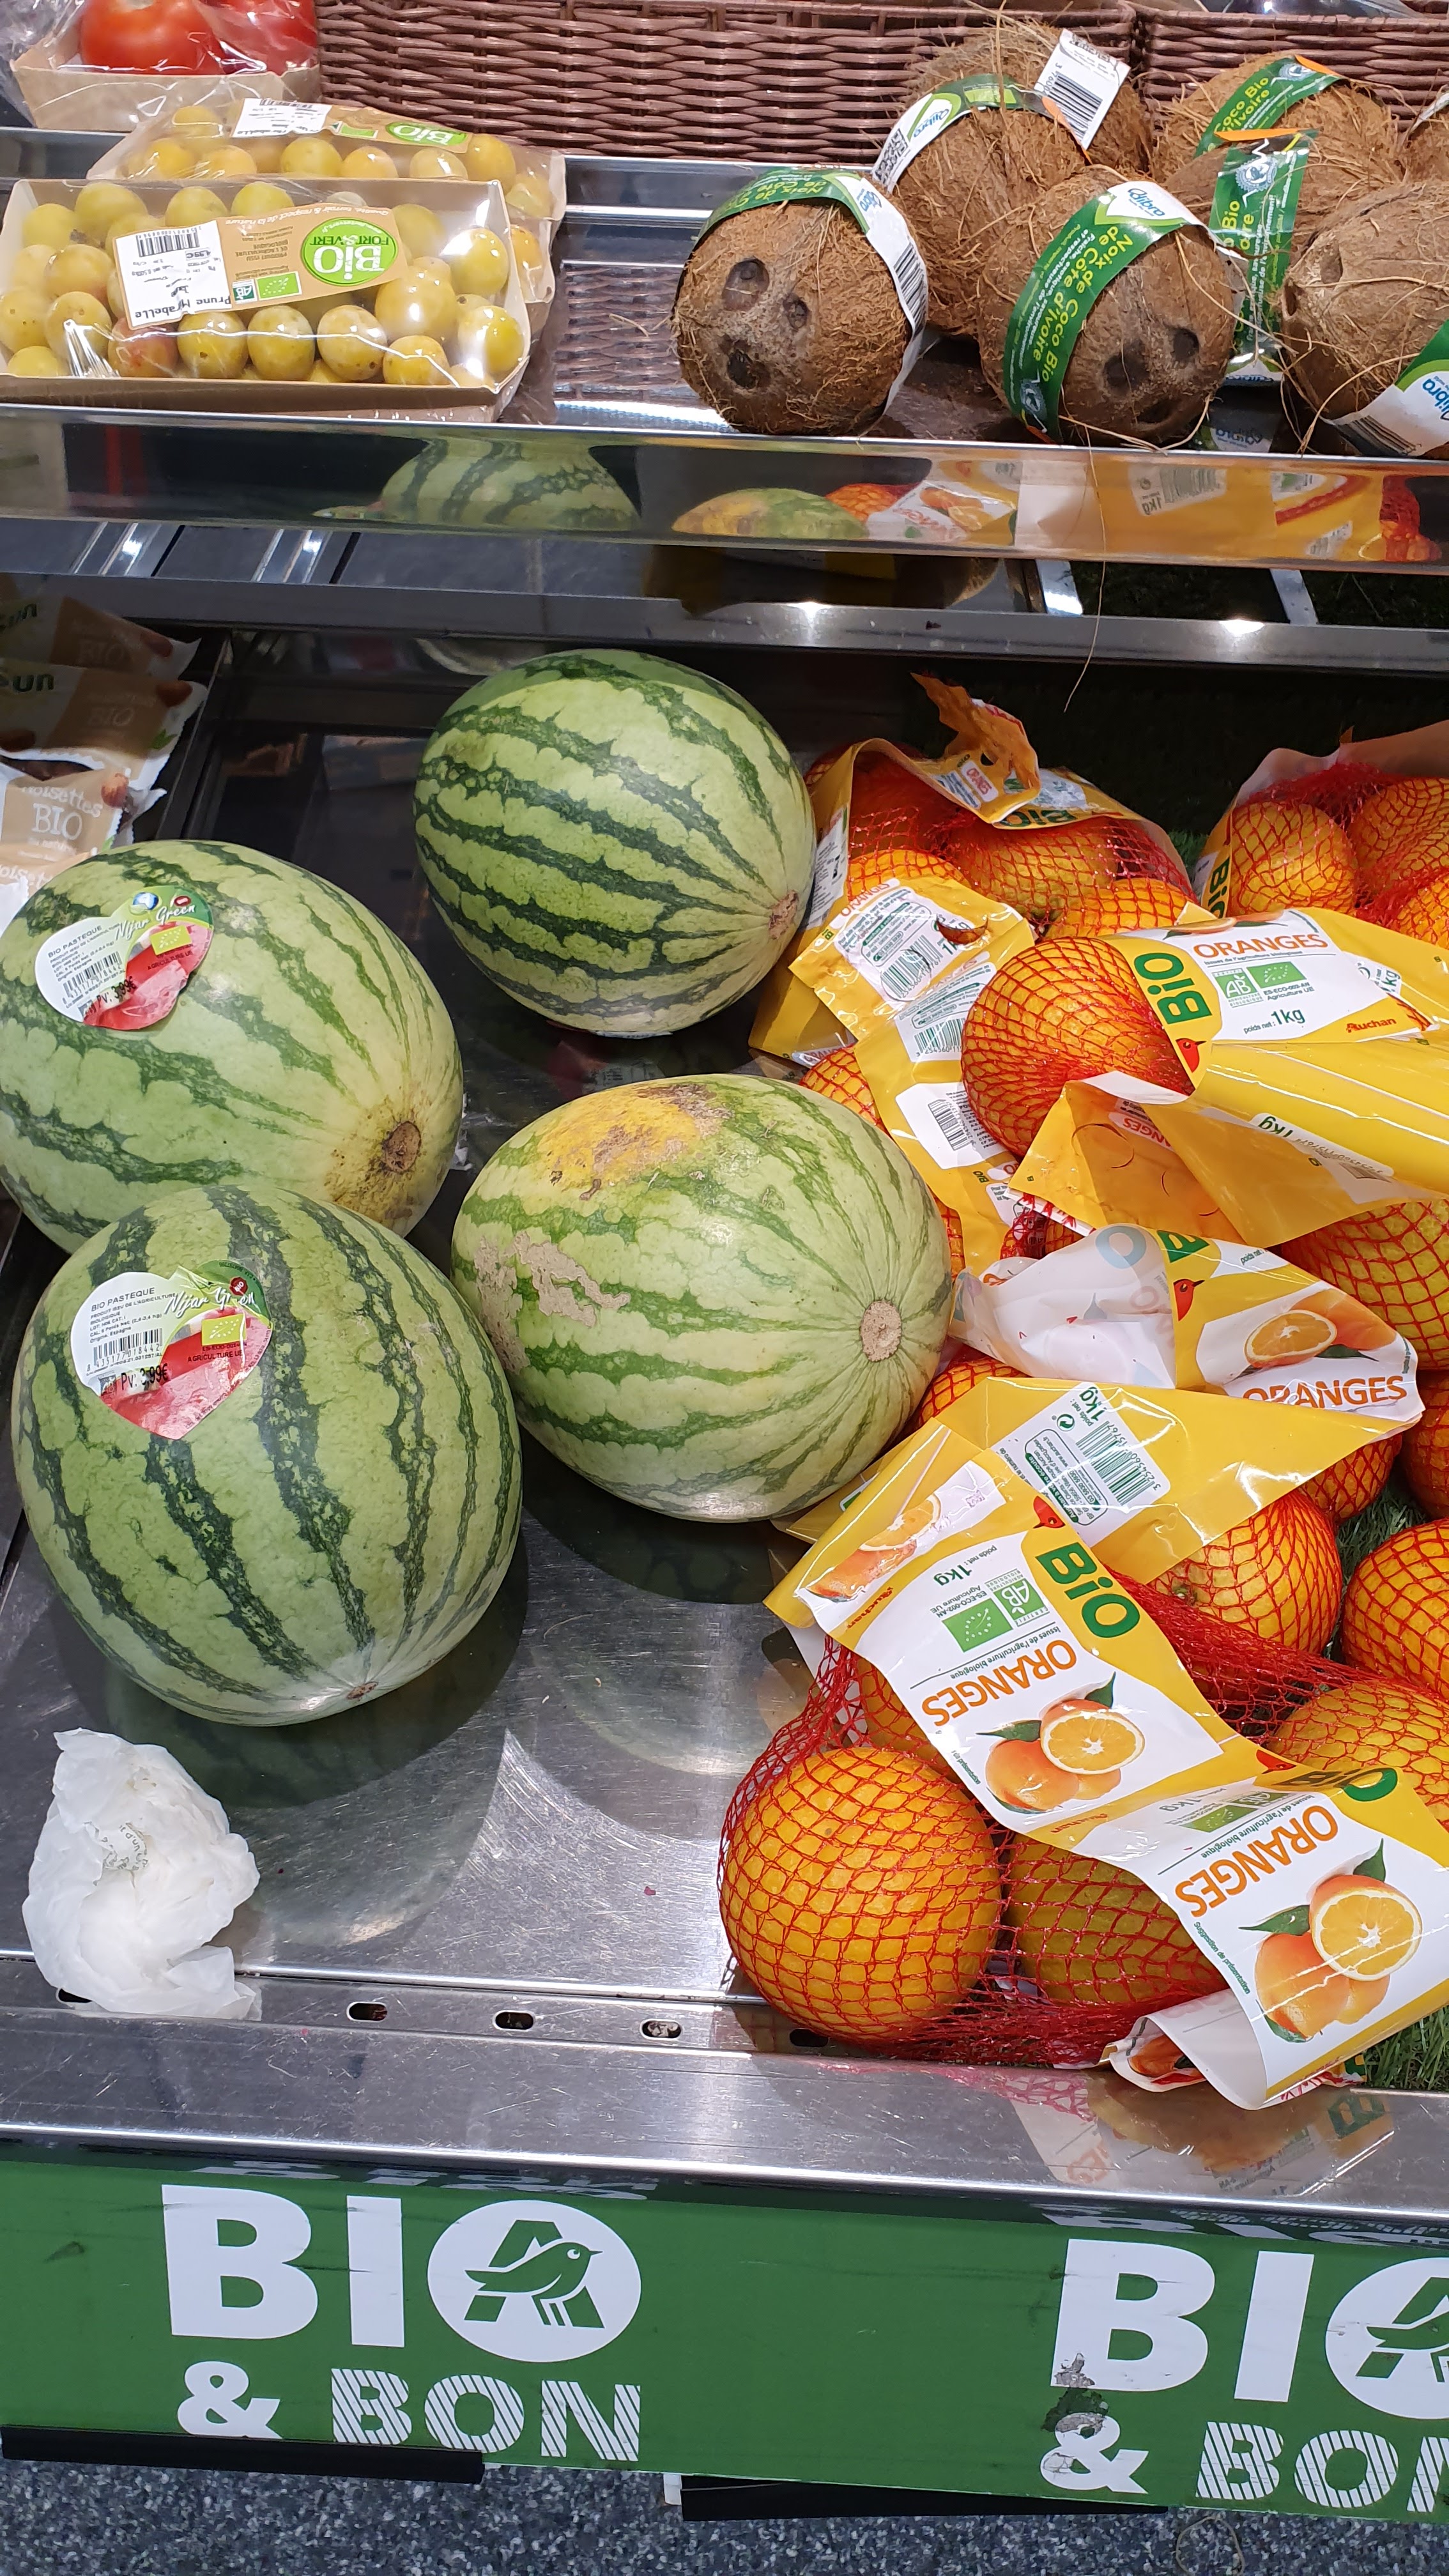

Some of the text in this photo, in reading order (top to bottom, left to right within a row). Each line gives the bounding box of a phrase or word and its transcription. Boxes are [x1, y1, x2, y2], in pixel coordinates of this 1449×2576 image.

[1245, 75, 1269, 99] Bio
[1222, 199, 1241, 229] Bio
[1098, 226, 1119, 246] de
[1062, 247, 1099, 288] Côte
[195, 296, 231, 305] Prune
[1041, 234, 1133, 382] Noix de Coco Bio
[32, 802, 83, 841] BIO
[155, 905, 196, 926] Green
[48, 924, 103, 958] BIO PASTEQUE
[1193, 933, 1328, 962] ORANGES
[1134, 950, 1212, 1025] BiO
[1266, 988, 1303, 1002] Agriculture
[1243, 1023, 1261, 1034] poids
[1271, 1006, 1306, 1027] 1kg
[1346, 1016, 1397, 1033] Auchan
[91, 1287, 155, 1312] BIO PASTEQUE
[233, 1281, 245, 1292] BIO
[90, 1308, 112, 1319] PRODUIT
[133, 1292, 176, 1306] L'AGRICULTURE
[90, 1312, 121, 1326] BIOLOGIQUE
[187, 1351, 234, 1363] AGRICULTURE
[1242, 1375, 1407, 1409] ORANGES
[1071, 1401, 1094, 1427] poids net
[1003, 1451, 1018, 1469] numéro
[1029, 1455, 1045, 1475] écoute
[1034, 1450, 1048, 1467] Auchan
[1131, 1453, 1156, 1482] 254560
[1078, 1482, 1090, 1495] 5930
[1086, 1512, 1094, 1520] BP
[933, 1544, 999, 1589] poids net 1kg
[929, 1584, 983, 1615] Agriculture UE
[935, 1589, 988, 1619] ES-ECO-002-AN
[1000, 1579, 1031, 1605] AB
[1035, 1542, 1141, 1639] BiO
[844, 1585, 894, 1631] Auchan
[949, 1635, 1040, 1683] de l'agriculture biologique
[921, 1639, 1078, 1726] ORANGES
[1239, 1808, 1284, 1841] l'agriculture
[1200, 1832, 1241, 1860] biologique
[1174, 1804, 1339, 1919] ORANGES
[1193, 1920, 1214, 1951] Suggestion
[1222, 1958, 1252, 1995] présentation
[162, 2184, 641, 2362] BIO
[177, 2361, 641, 2462] & BON
[1040, 2412, 1148, 2494] &
